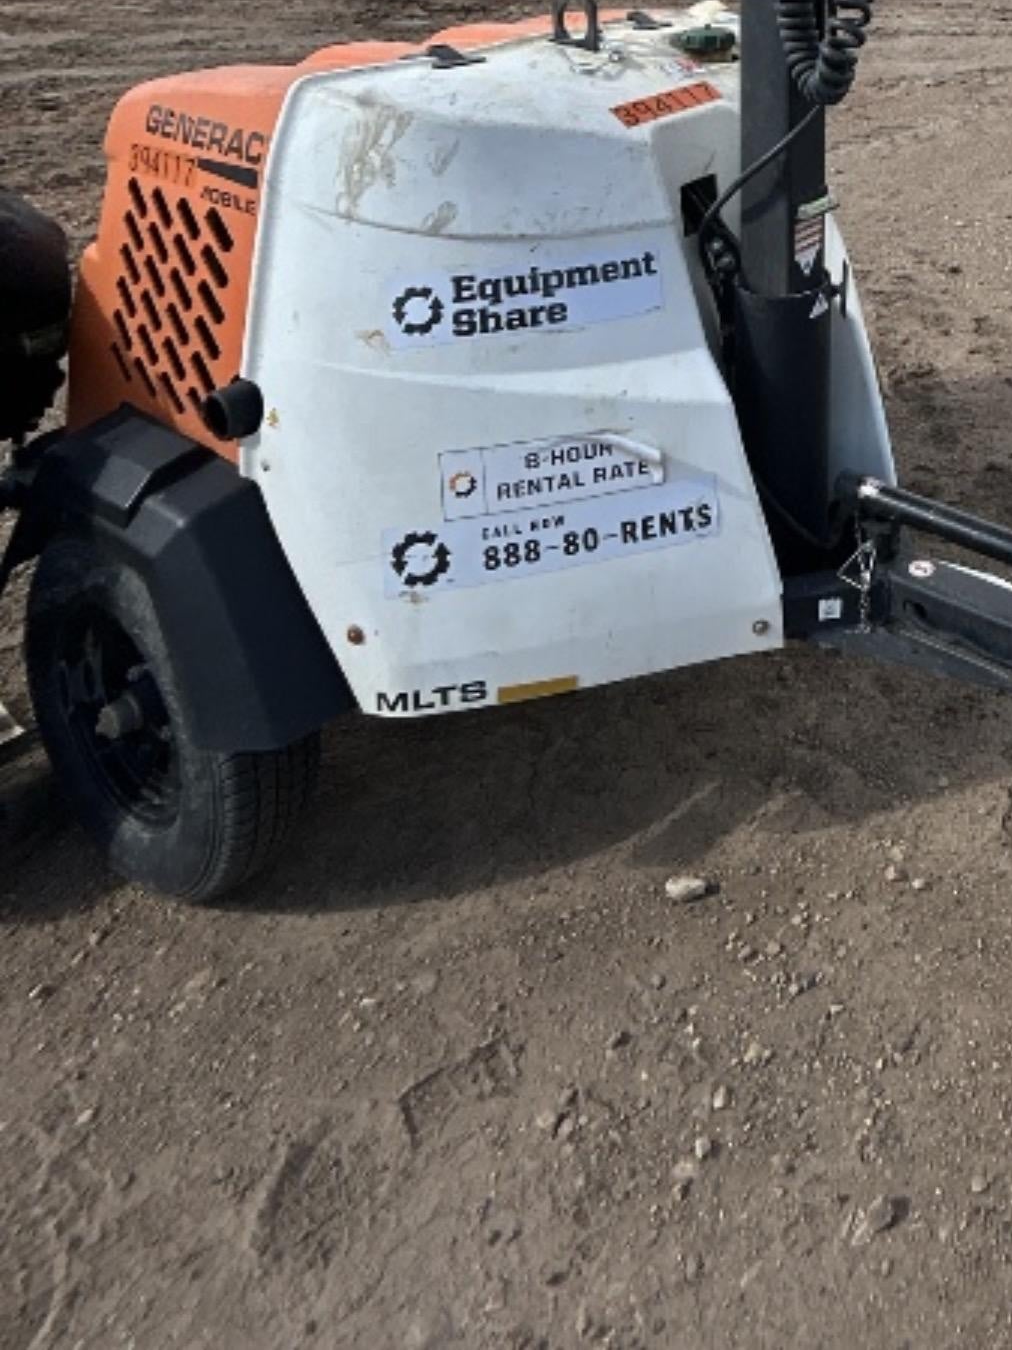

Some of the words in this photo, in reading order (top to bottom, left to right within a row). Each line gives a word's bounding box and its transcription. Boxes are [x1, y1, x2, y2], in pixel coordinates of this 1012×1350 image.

[145, 104, 266, 165] GENERAC
[451, 250, 657, 305] Equipment
[451, 302, 568, 337] Share
[496, 470, 586, 501] RENTAL
[592, 461, 650, 484] RATE
[482, 502, 713, 572] 888-80-RENTS
[376, 680, 488, 712] MLTS
